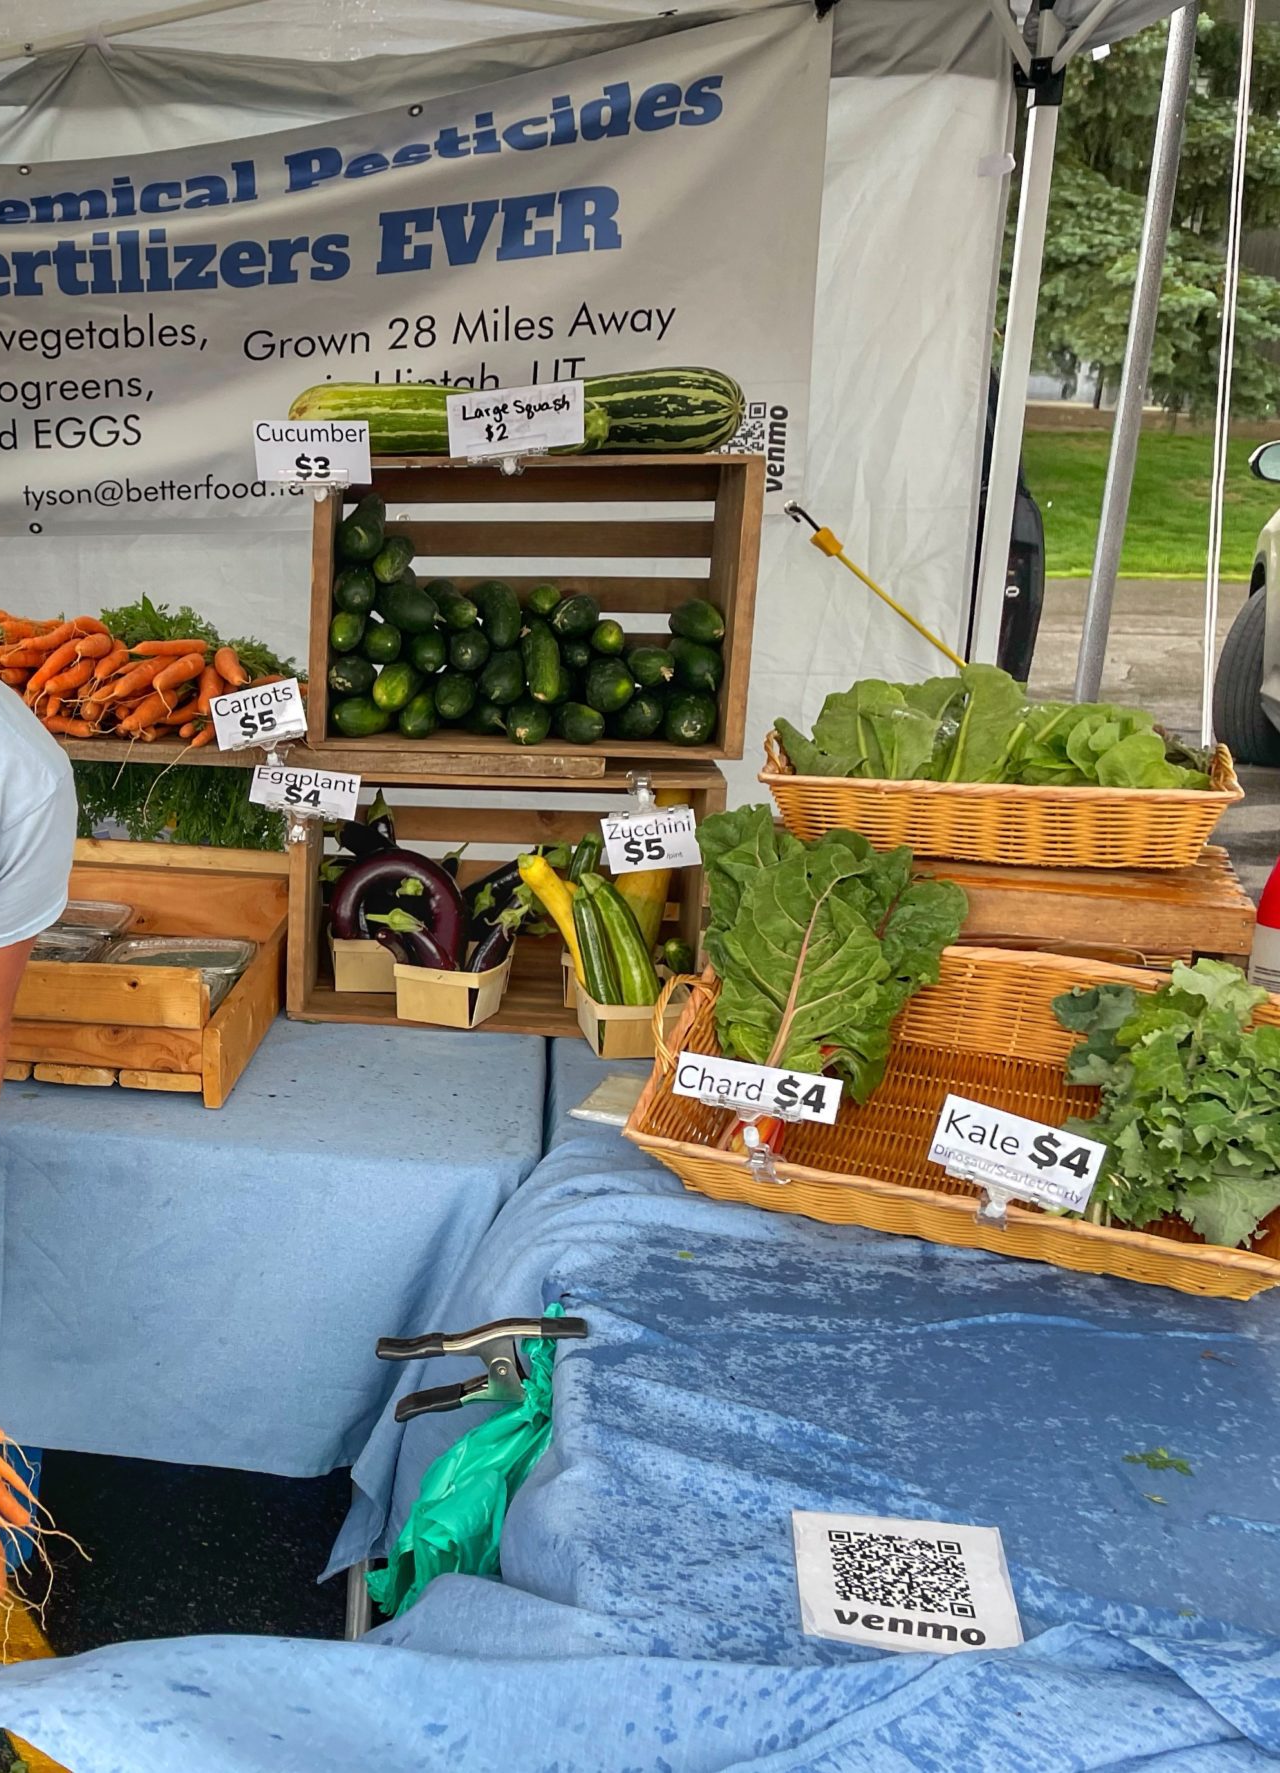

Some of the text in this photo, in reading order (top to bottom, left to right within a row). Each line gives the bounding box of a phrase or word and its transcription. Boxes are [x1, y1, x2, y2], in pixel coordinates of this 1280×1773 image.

[285, 75, 723, 193] Pesticides
[377, 186, 622, 275] EVER
[243, 302, 677, 361] Grown 28 Miles Away
[462, 394, 570, 422] Large Squash
[33, 414, 142, 449] EGGS
[256, 423, 367, 442] Cucumber
[485, 423, 509, 442] $2
[766, 405, 789, 493] venmo
[295, 453, 331, 480] $3
[214, 685, 293, 717] Carrots
[239, 710, 277, 738] $5
[257, 767, 356, 794] Eggplant
[284, 783, 321, 807] $4
[607, 816, 692, 840] Zucchini
[623, 838, 665, 865] $5
[678, 1065, 826, 1113] Chard $4
[944, 1109, 1092, 1179] Kale $4
[934, 1144, 1084, 1204] Dinosaur/Scarlet/Curly
[833, 1608, 987, 1646] venmo
